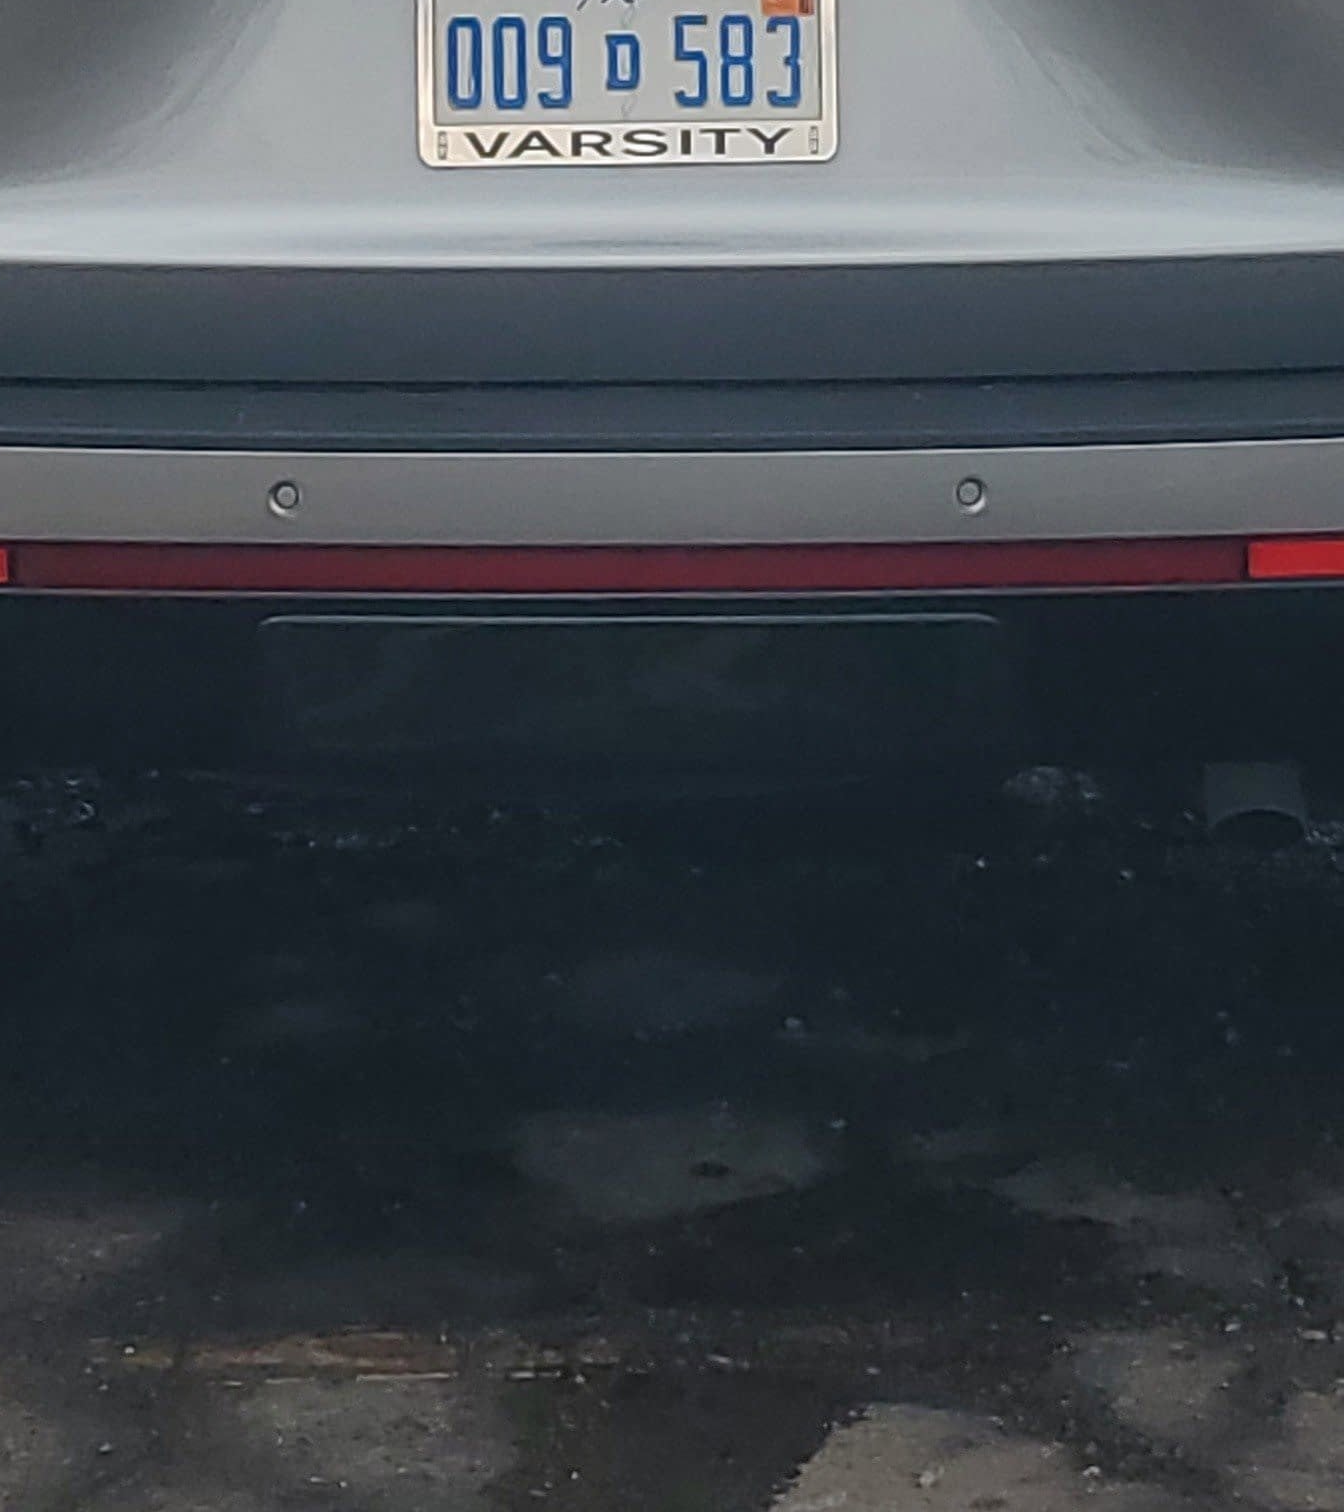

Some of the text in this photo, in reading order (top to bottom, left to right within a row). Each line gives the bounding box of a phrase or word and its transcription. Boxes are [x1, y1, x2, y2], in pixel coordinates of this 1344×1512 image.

[447, 13, 803, 110] 009 D 583
[465, 127, 793, 159] VARSITY
